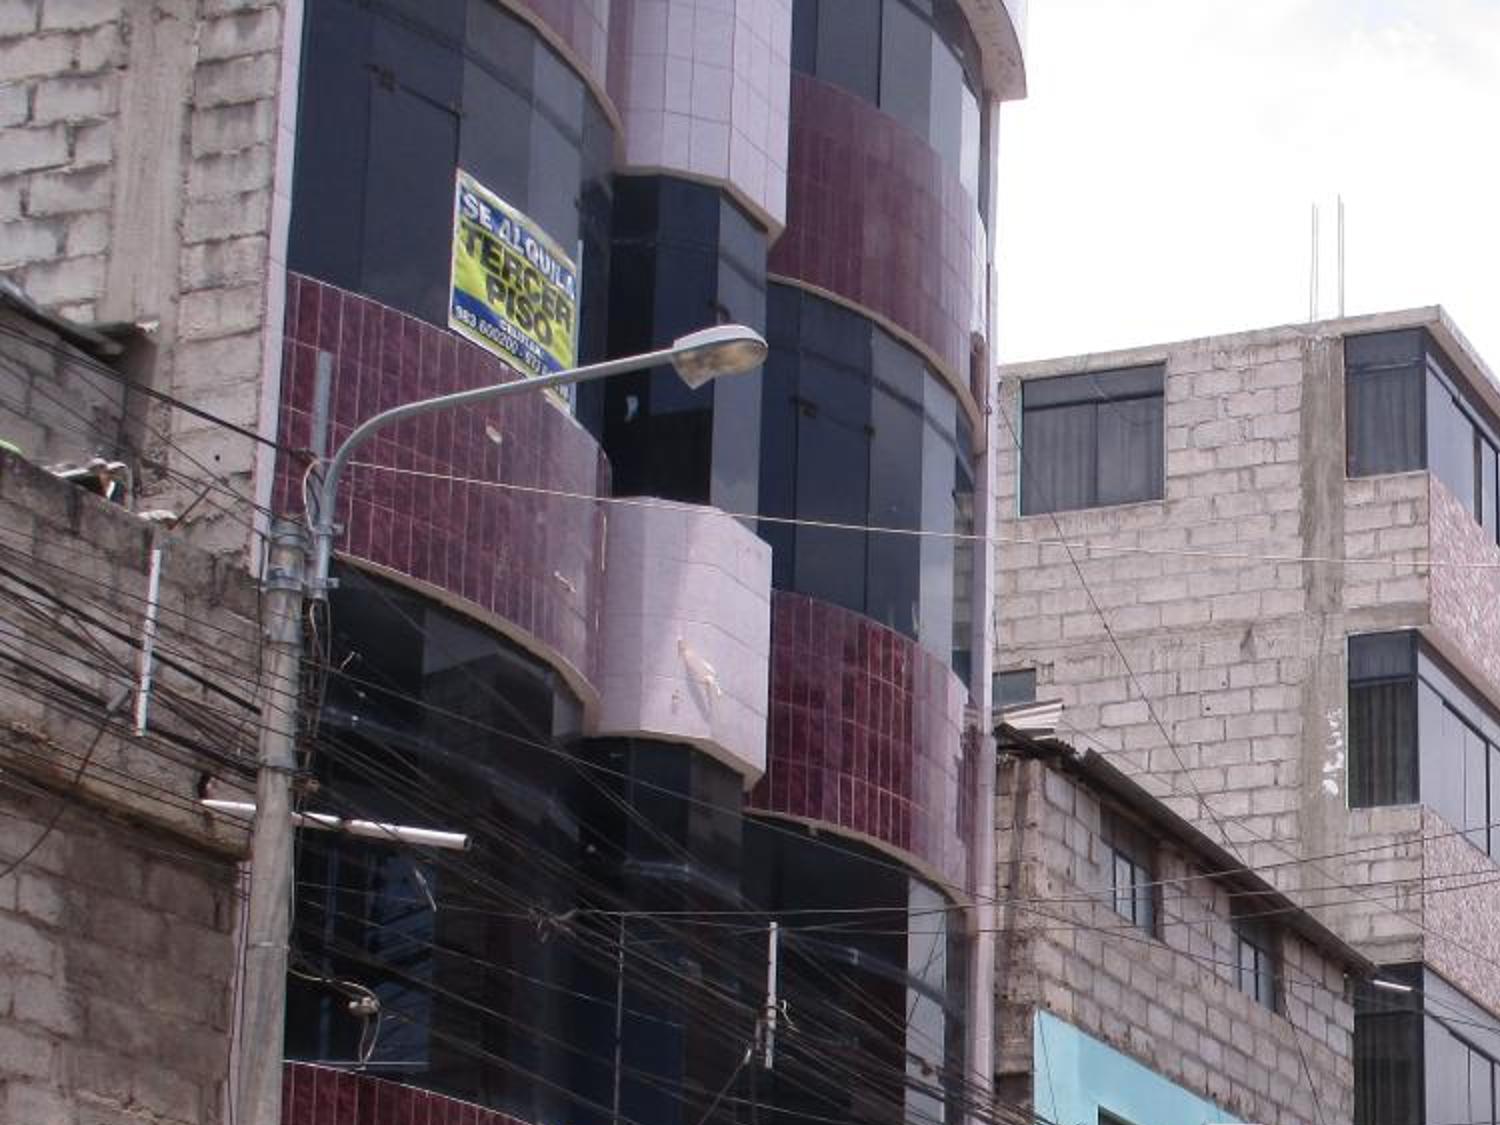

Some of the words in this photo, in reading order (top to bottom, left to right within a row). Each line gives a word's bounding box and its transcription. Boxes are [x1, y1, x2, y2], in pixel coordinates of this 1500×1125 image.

[461, 228, 572, 334] TERCER
[462, 192, 492, 227] SE
[498, 217, 576, 300] ALQUILA
[485, 275, 551, 346] PISO
